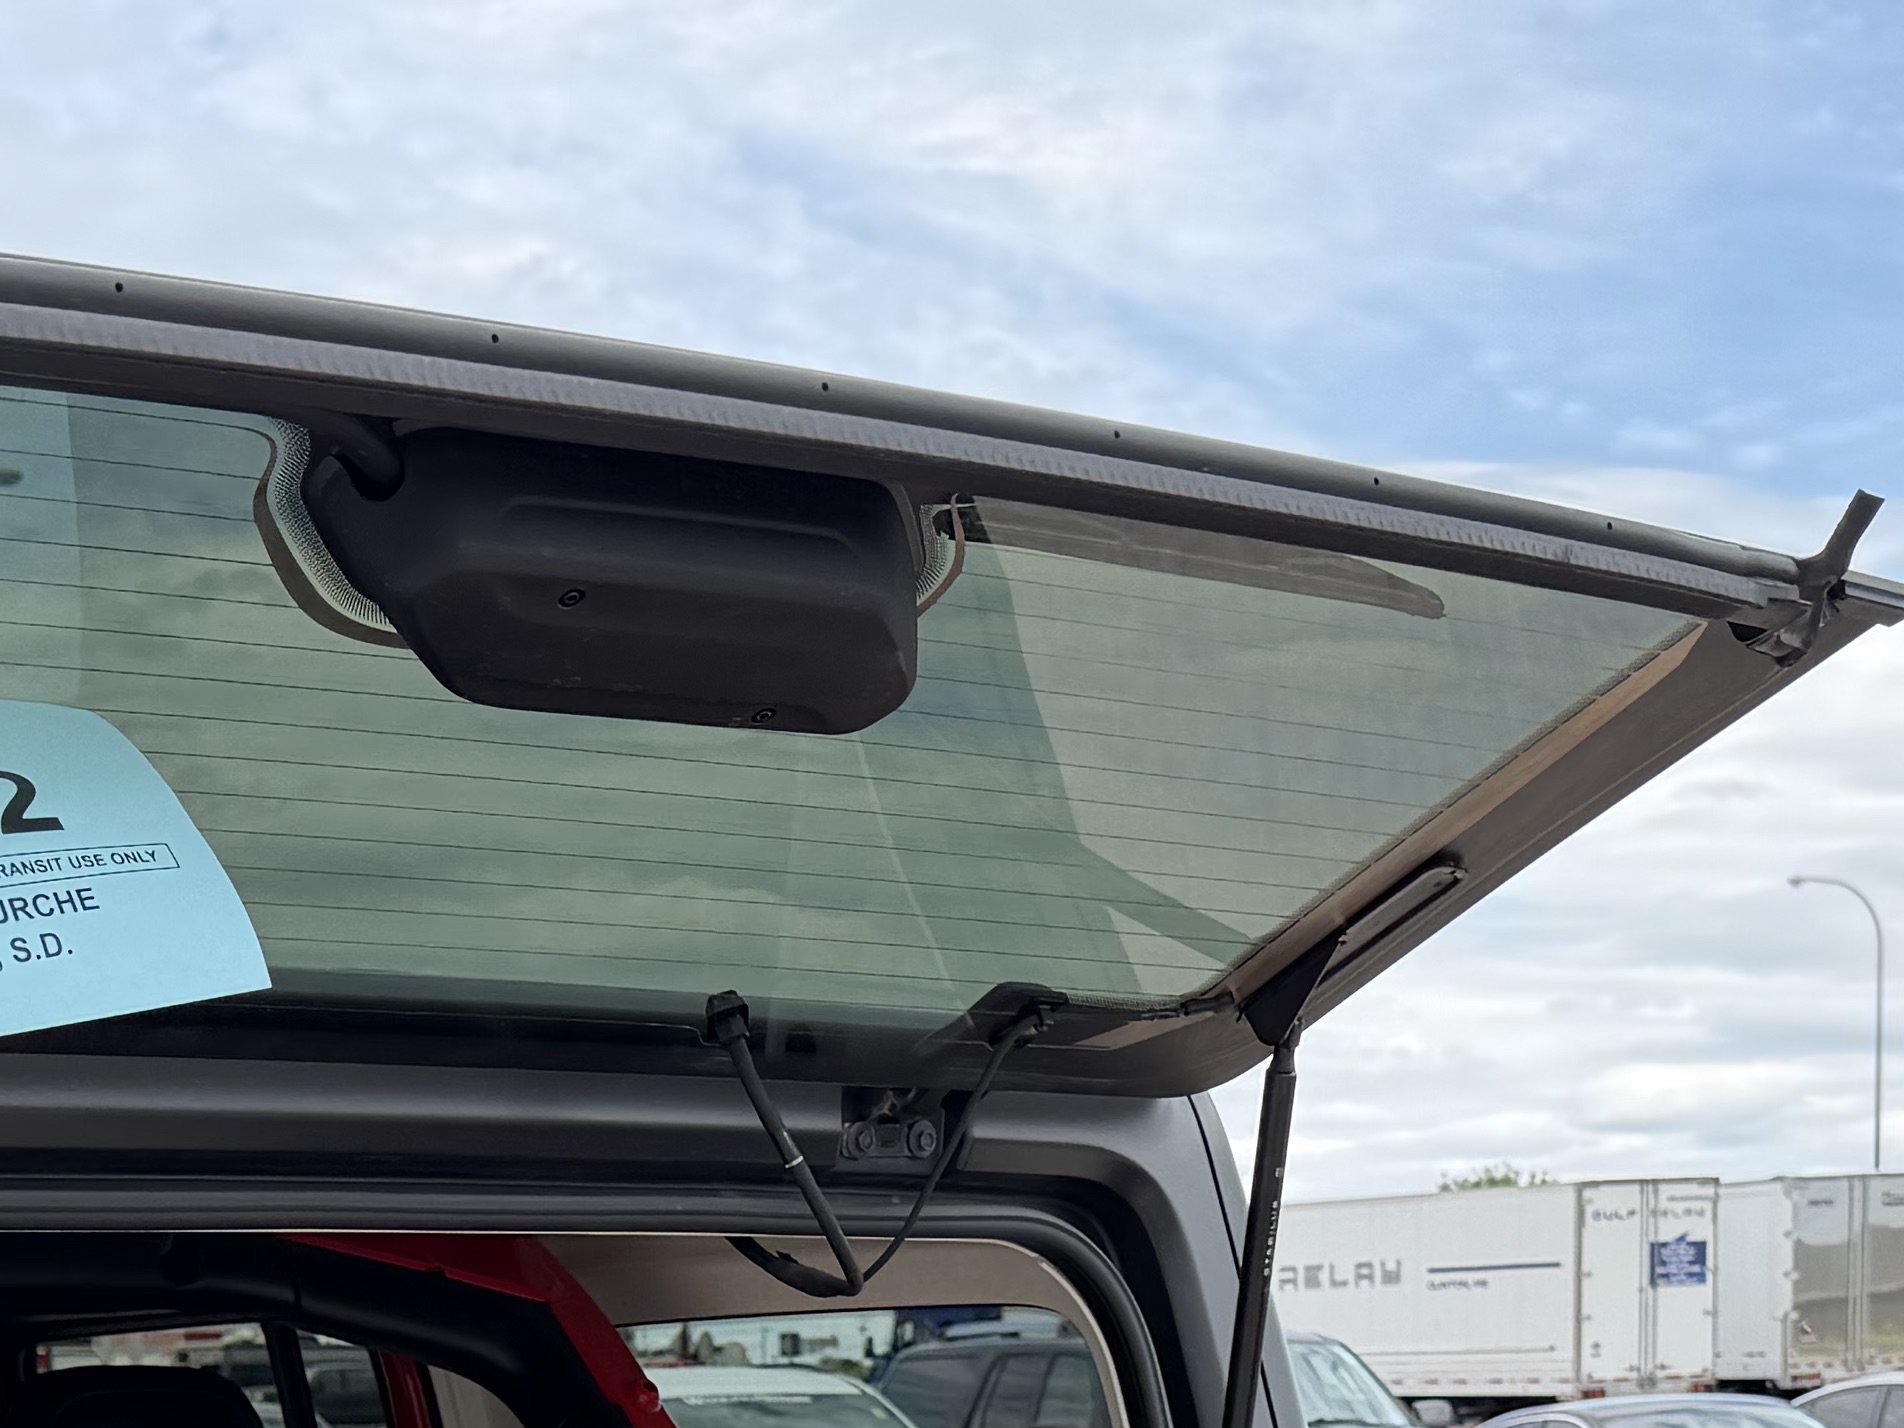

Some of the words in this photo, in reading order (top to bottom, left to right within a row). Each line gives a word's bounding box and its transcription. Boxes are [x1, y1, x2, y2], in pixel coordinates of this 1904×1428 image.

[71, 853, 107, 870] USE
[110, 849, 158, 866] ONLY
[9, 932, 74, 963] S.D.
